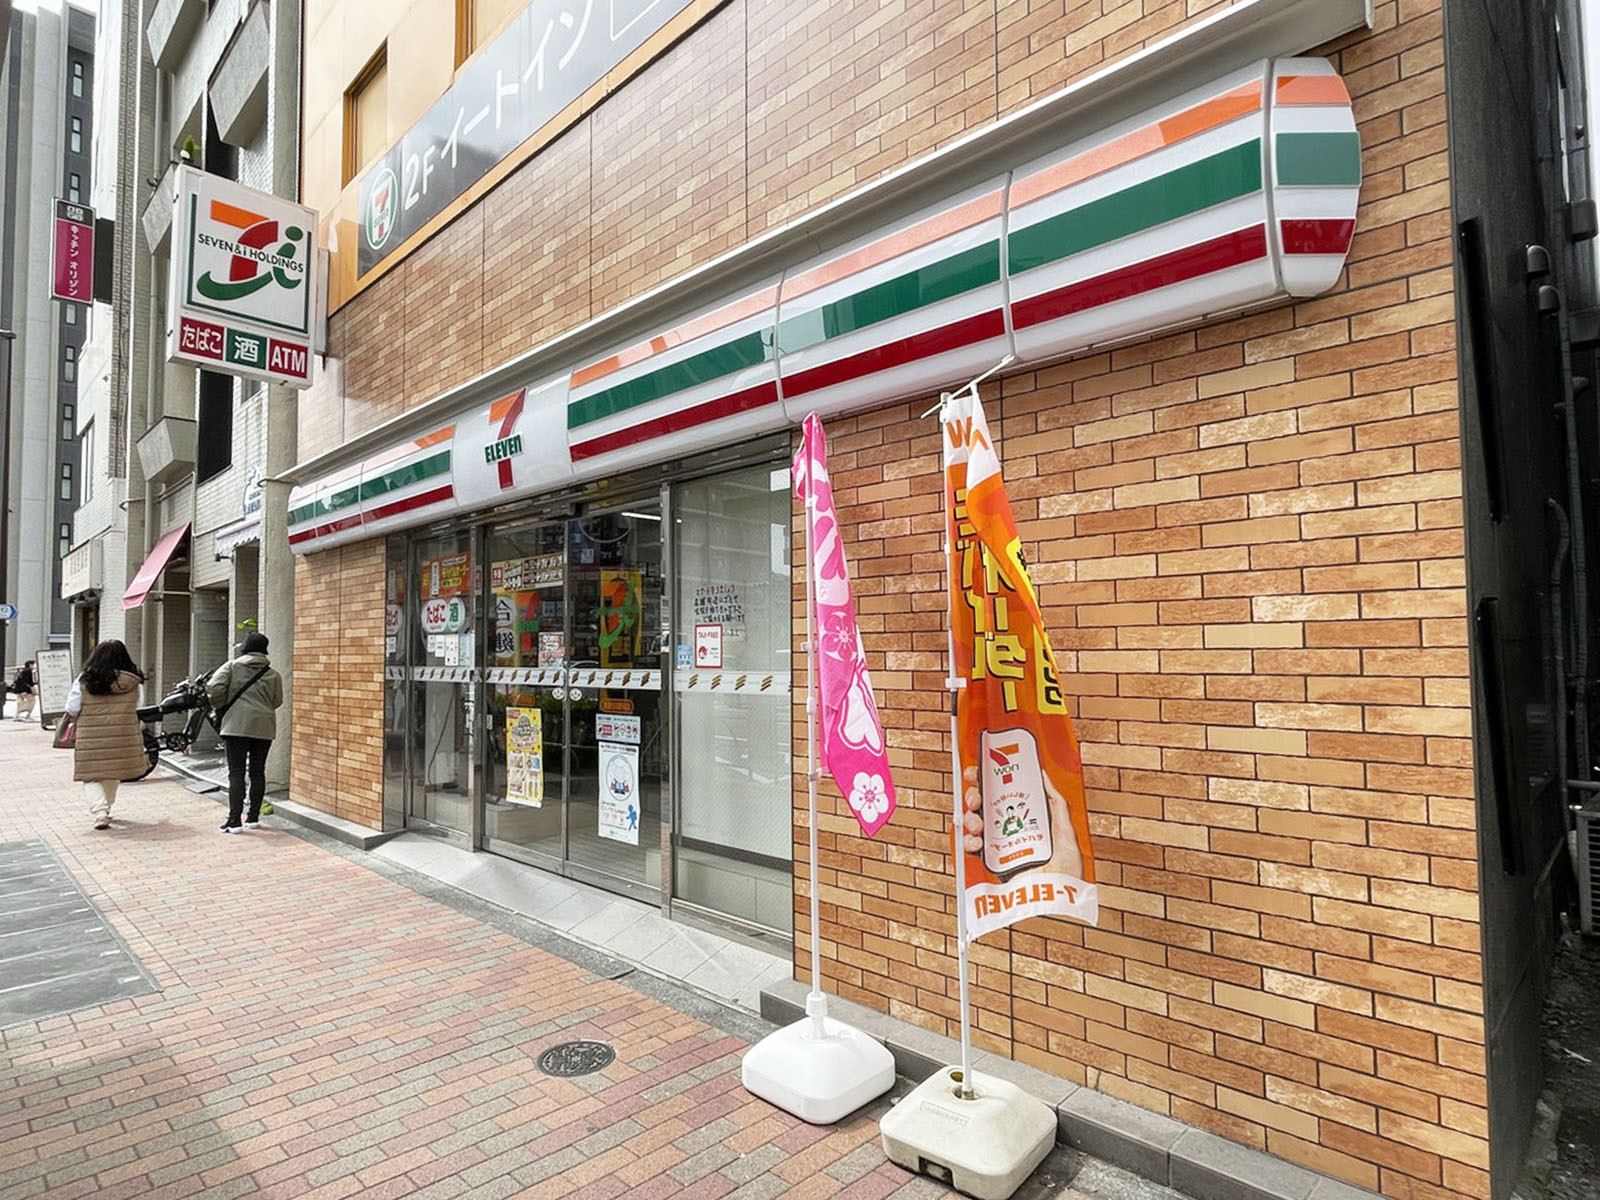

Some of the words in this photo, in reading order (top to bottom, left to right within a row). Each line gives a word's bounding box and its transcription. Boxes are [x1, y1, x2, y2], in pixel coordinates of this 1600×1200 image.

[250, 250, 304, 273] HOLDINGS
[181, 324, 222, 355] たばこ
[234, 335, 260, 363] 酒
[271, 345, 306, 374] ATM
[426, 603, 446, 624] たばこ
